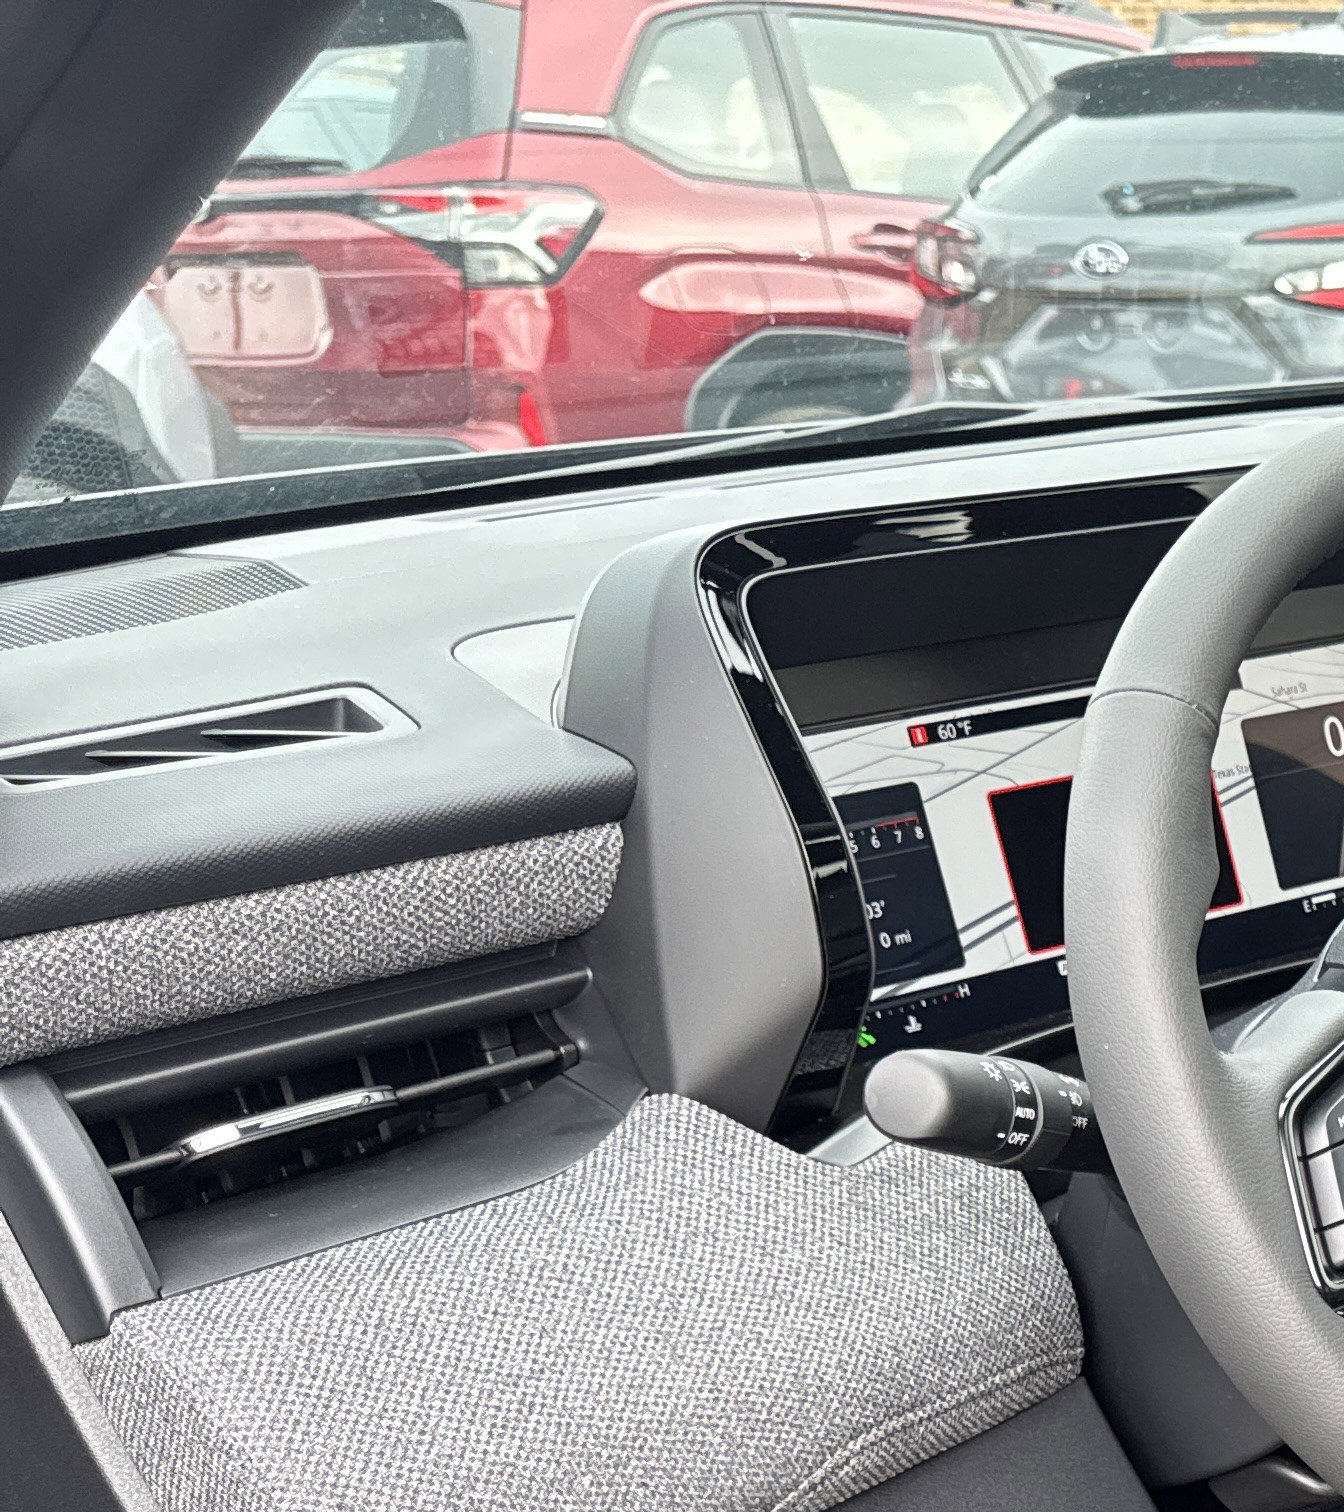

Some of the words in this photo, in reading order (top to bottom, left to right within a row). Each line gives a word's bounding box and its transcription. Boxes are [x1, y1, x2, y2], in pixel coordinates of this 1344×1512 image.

[937, 720, 972, 740] 60°F
[870, 833, 881, 849] 6
[893, 829, 902, 844] 7
[914, 825, 924, 840] 8
[879, 931, 891, 949] 0
[894, 929, 912, 946] mi
[958, 983, 971, 999] H
[1015, 1106, 1036, 1121] AUTO
[1008, 1131, 1030, 1147] OFF
